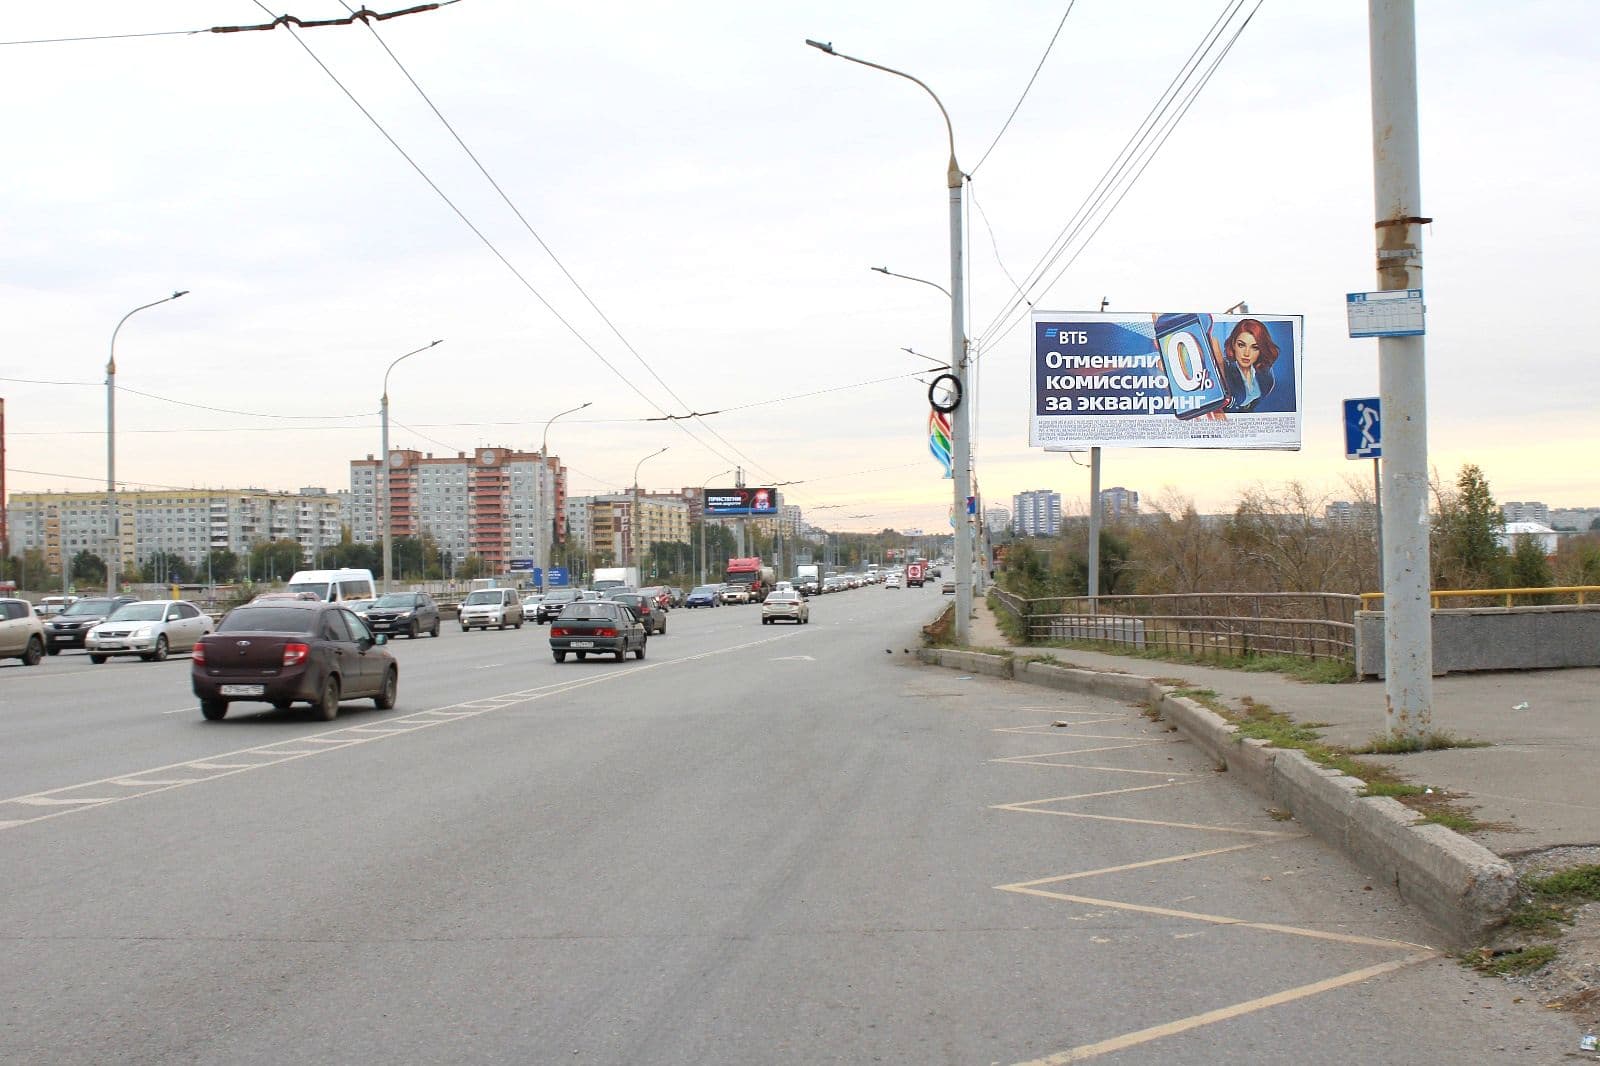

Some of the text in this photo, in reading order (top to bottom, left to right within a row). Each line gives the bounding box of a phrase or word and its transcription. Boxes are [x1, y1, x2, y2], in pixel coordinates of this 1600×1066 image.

[1059, 331, 1088, 345] ВТБ
[1045, 351, 1161, 369] Отменили
[1045, 375, 1169, 390] комиссию
[1045, 392, 1206, 415] за эквайринг
